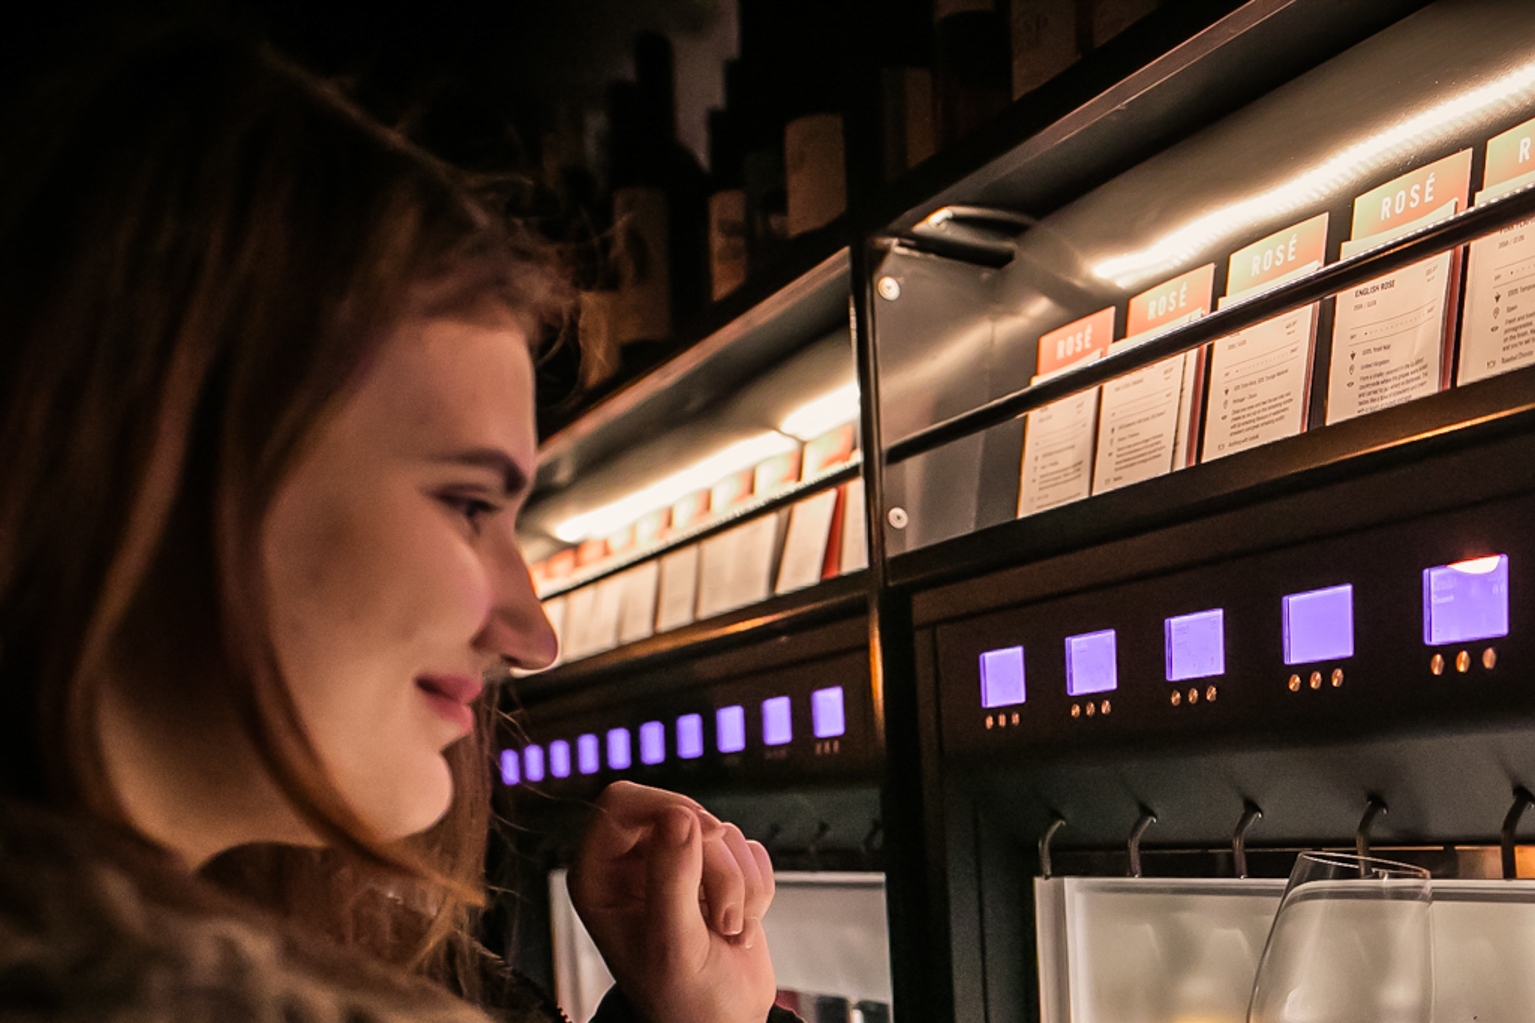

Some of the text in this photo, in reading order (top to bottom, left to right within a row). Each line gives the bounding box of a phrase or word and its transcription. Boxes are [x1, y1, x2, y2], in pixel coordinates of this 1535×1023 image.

[1380, 173, 1436, 221] ROSÉ
[1251, 234, 1298, 277] ROSÉ
[1147, 282, 1187, 321] ROSÉ
[1355, 284, 1380, 298] ENGLISH
[1056, 324, 1093, 360] ROSÉ
